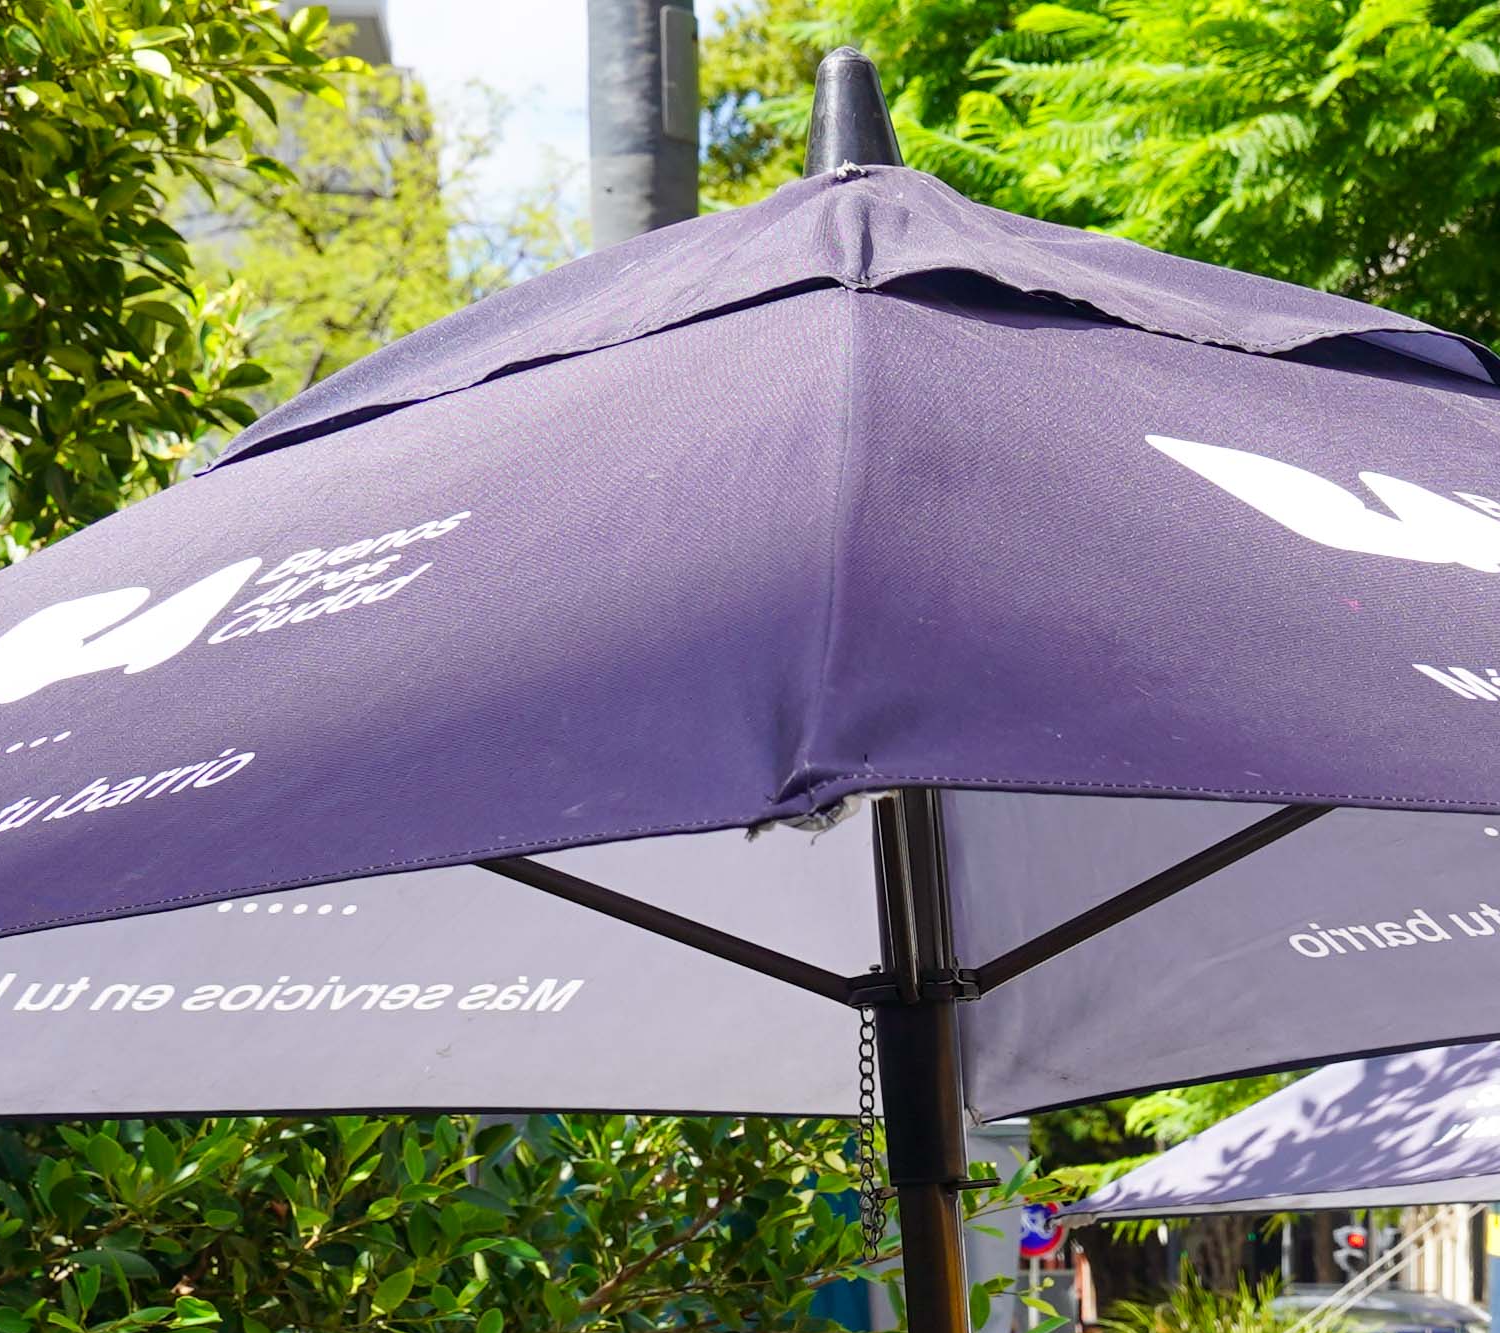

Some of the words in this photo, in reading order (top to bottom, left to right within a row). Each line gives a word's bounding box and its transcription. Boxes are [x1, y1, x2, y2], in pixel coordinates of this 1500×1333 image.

[255, 511, 472, 584] Buenos
[207, 562, 433, 645] Ciudad
[233, 554, 402, 615] Aires
[42, 747, 256, 821] barrio
